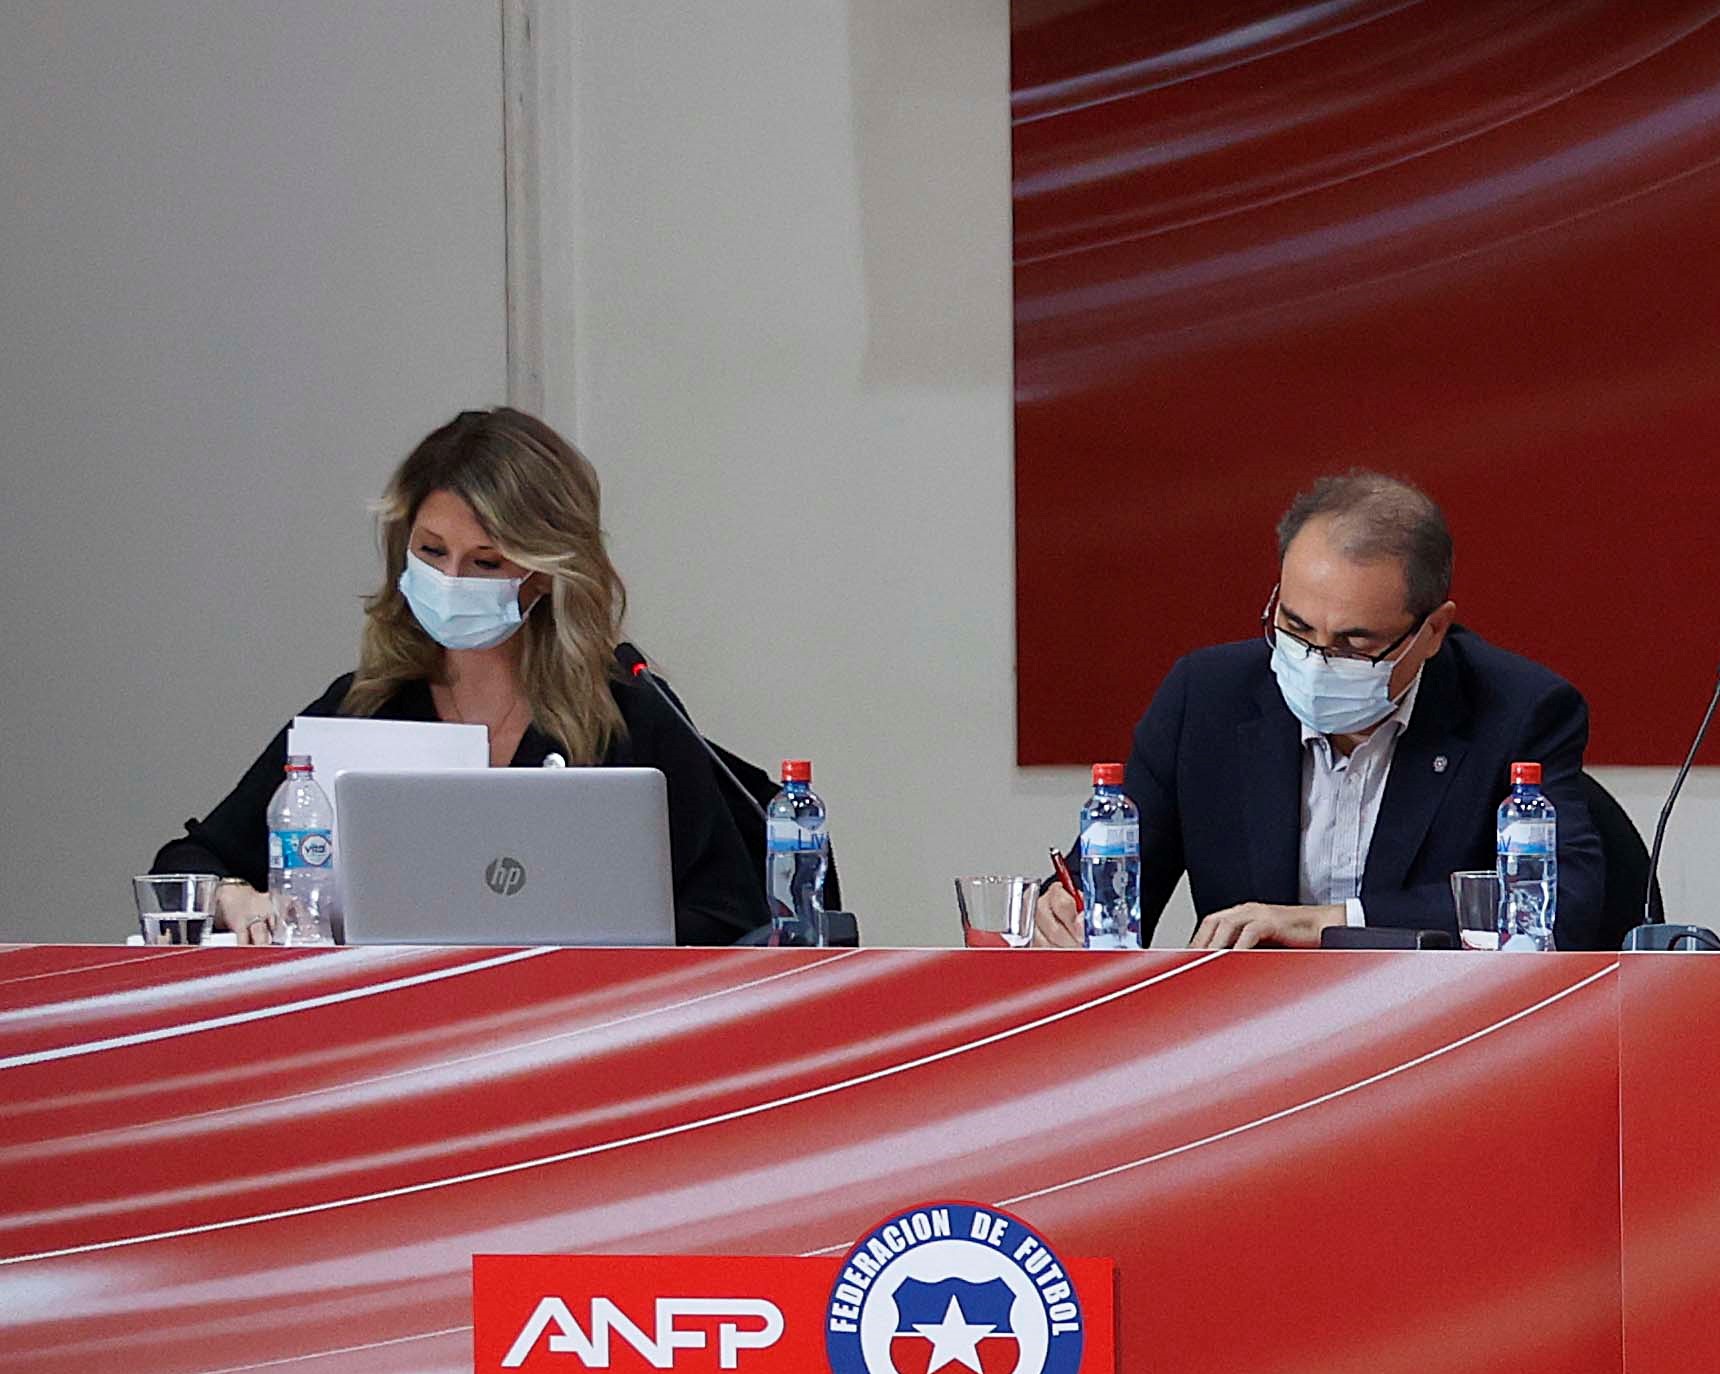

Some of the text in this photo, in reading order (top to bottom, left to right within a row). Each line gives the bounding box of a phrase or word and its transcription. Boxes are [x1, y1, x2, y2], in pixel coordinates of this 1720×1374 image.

[491, 855, 522, 896] hp
[830, 1208, 1080, 1337] FEDERACION DE FUTBOL
[501, 1296, 785, 1368] ANFP
